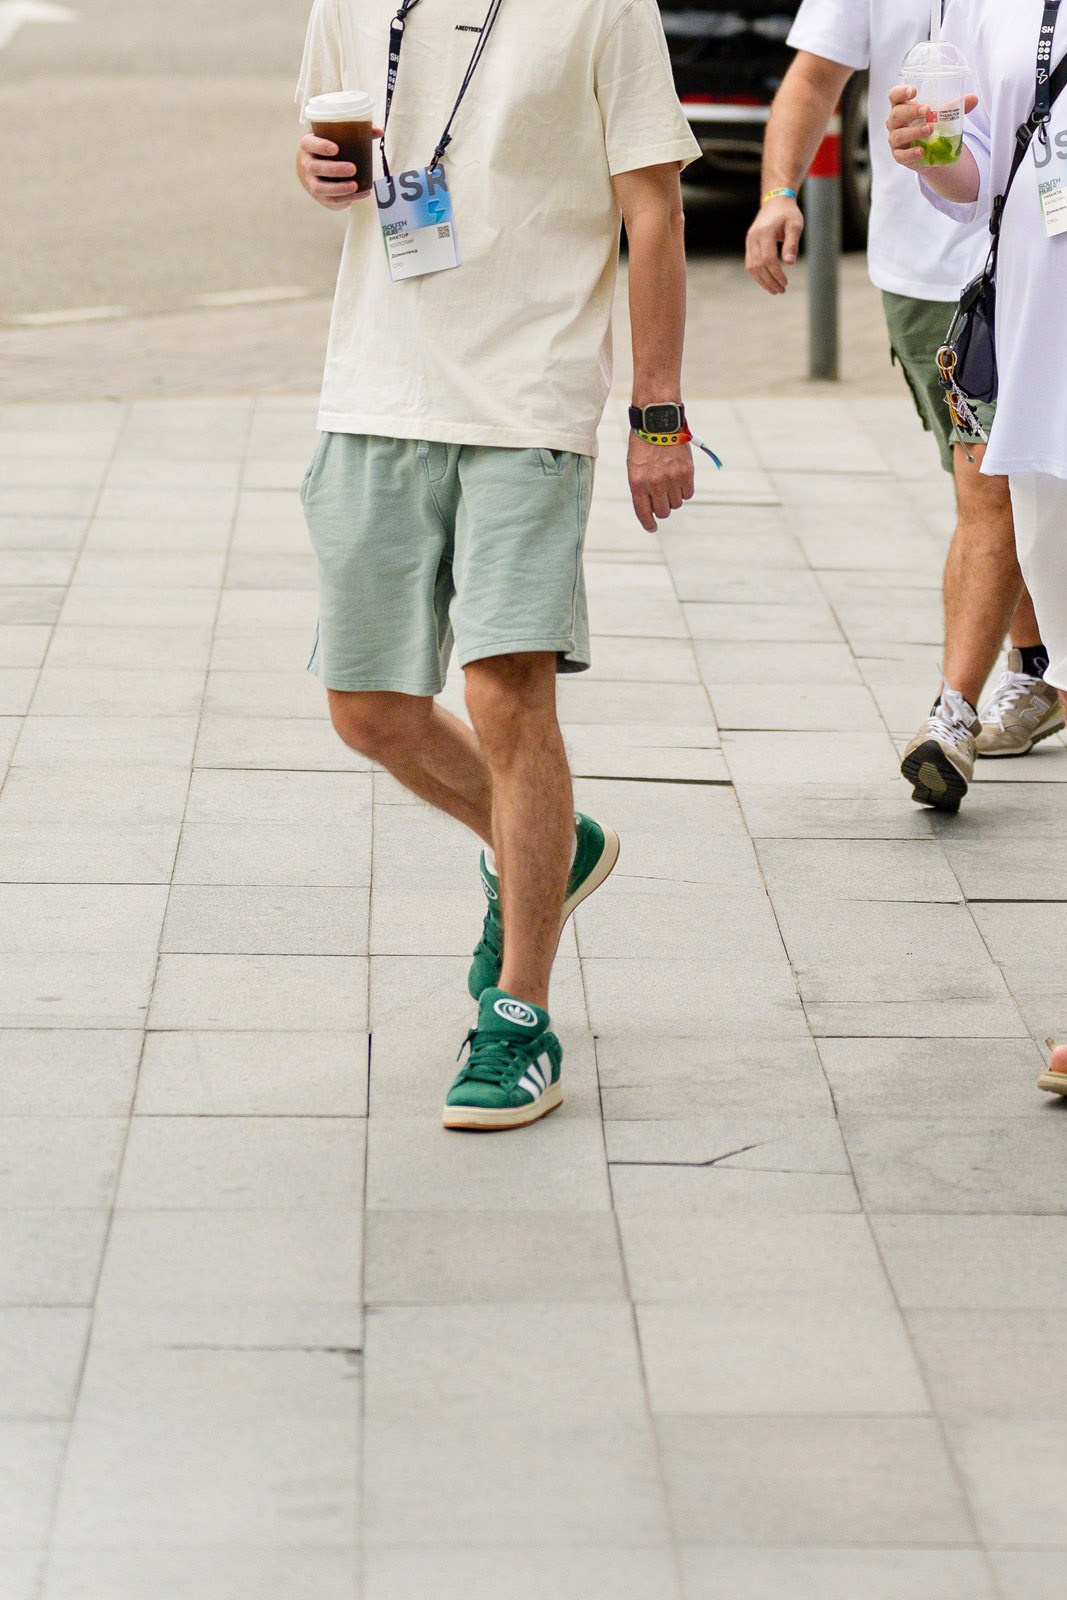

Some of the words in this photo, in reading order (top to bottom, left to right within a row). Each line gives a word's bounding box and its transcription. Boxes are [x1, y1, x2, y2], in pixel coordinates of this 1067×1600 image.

[1041, 25, 1054, 34] SH
[390, 52, 399, 62] SH
[374, 162, 449, 209] USR
[1038, 177, 1061, 189] SOUTH
[382, 220, 408, 232] SOUTH
